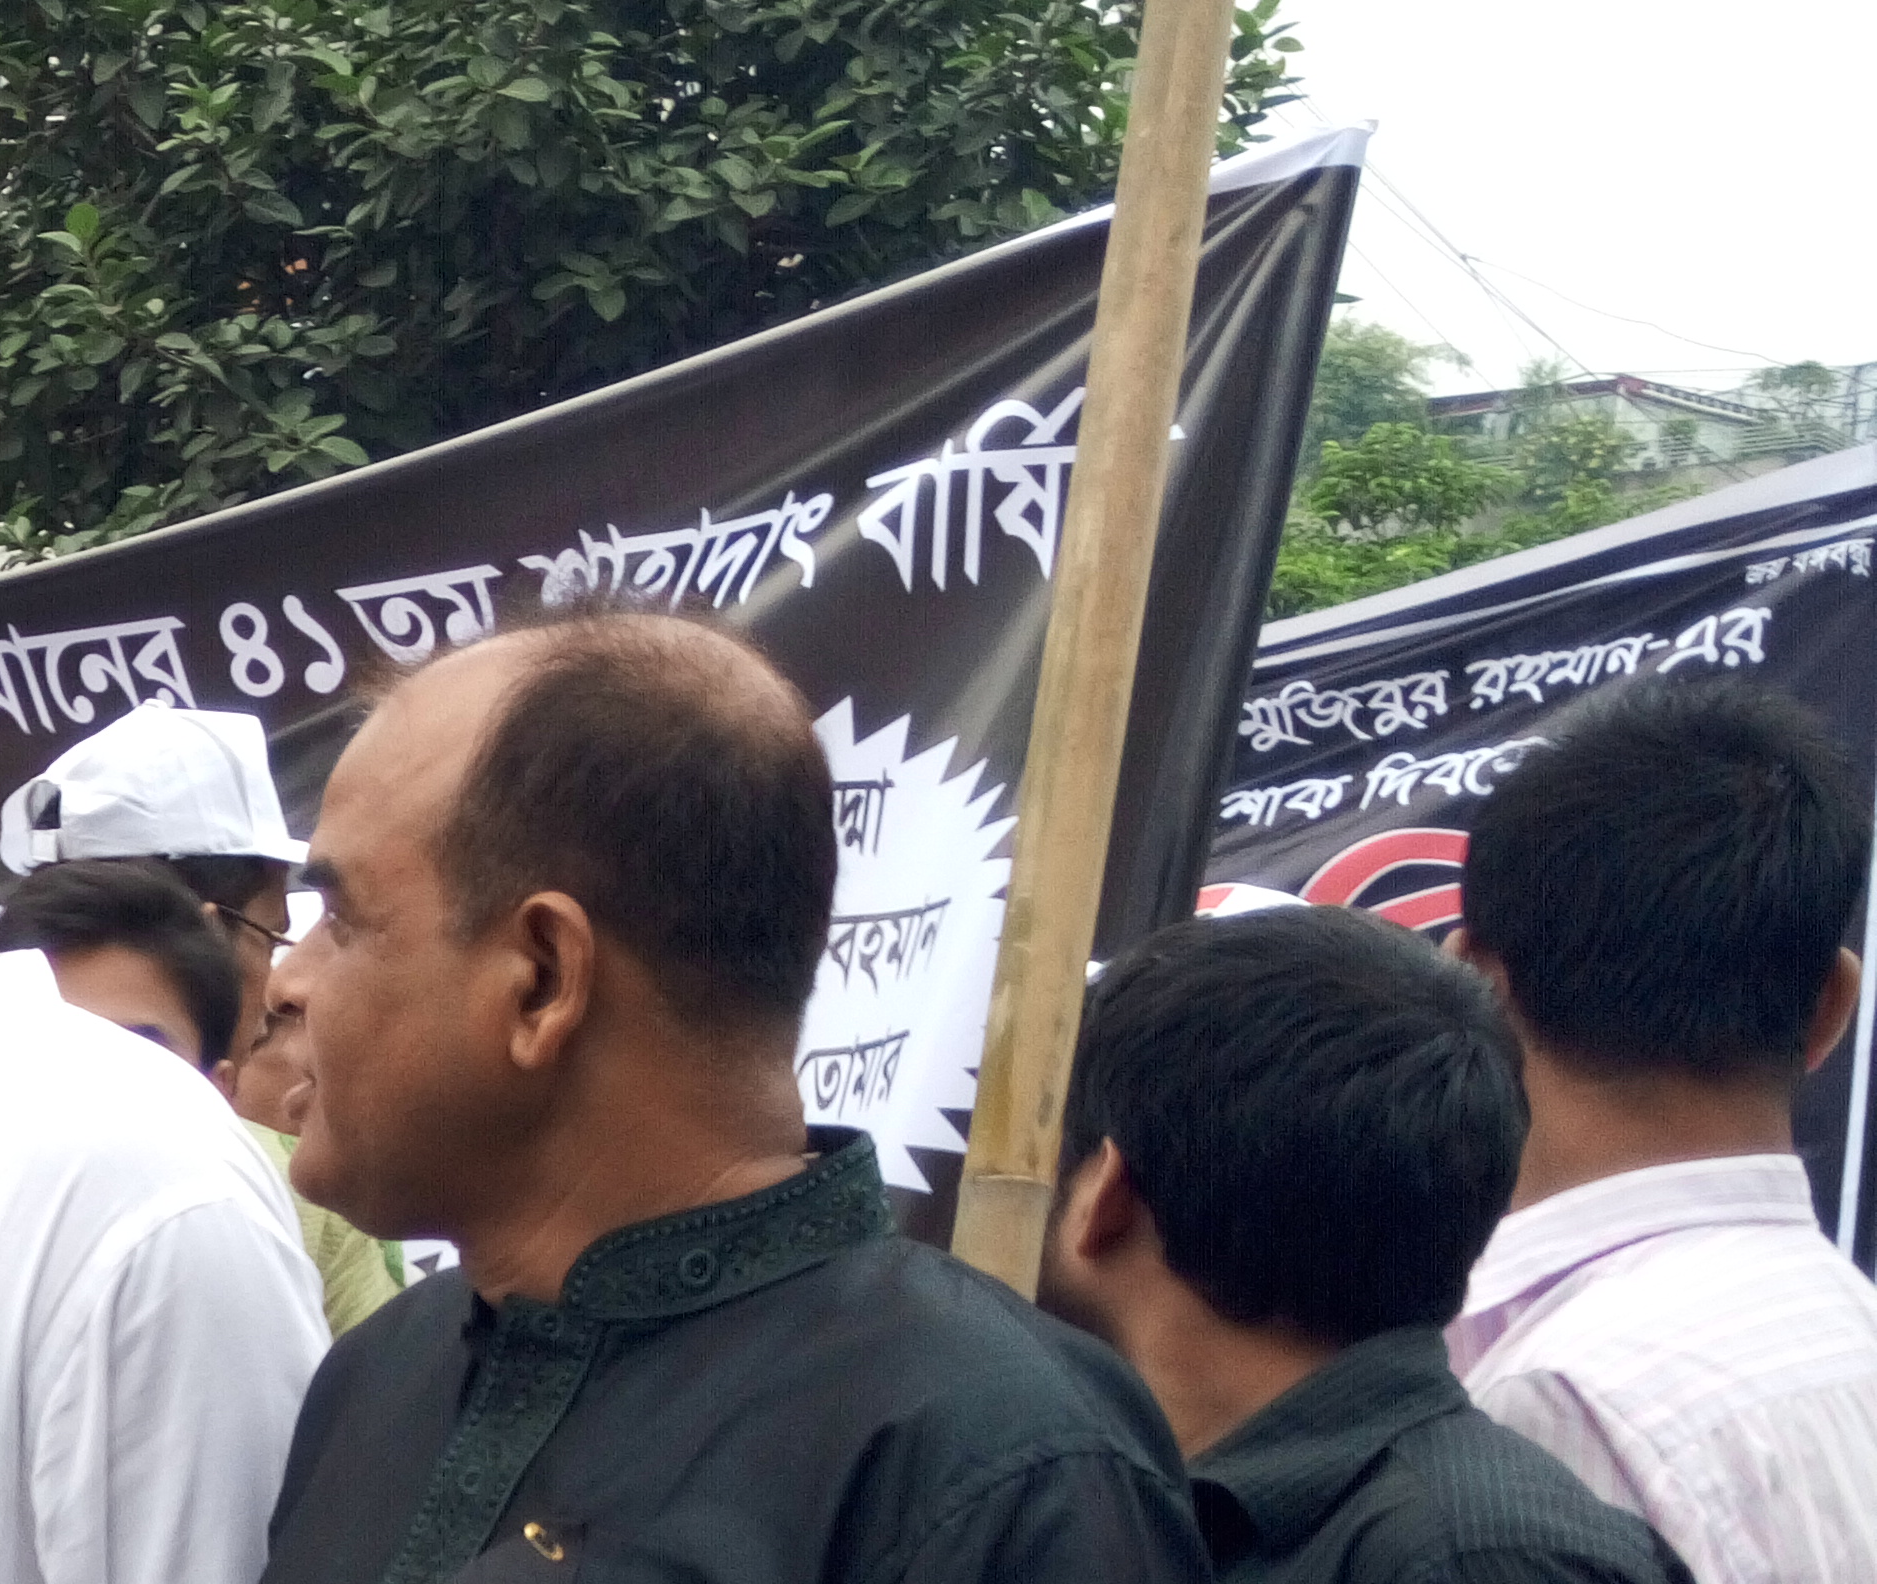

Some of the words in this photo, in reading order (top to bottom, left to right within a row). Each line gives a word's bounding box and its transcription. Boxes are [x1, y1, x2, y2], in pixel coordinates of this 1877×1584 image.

[219, 593, 345, 698] ৪১
[334, 563, 504, 666] তম
[856, 385, 1087, 593] বার্ষি
[1237, 680, 1451, 752] মুজিবুর
[1465, 606, 1773, 710] রহমান-এর
